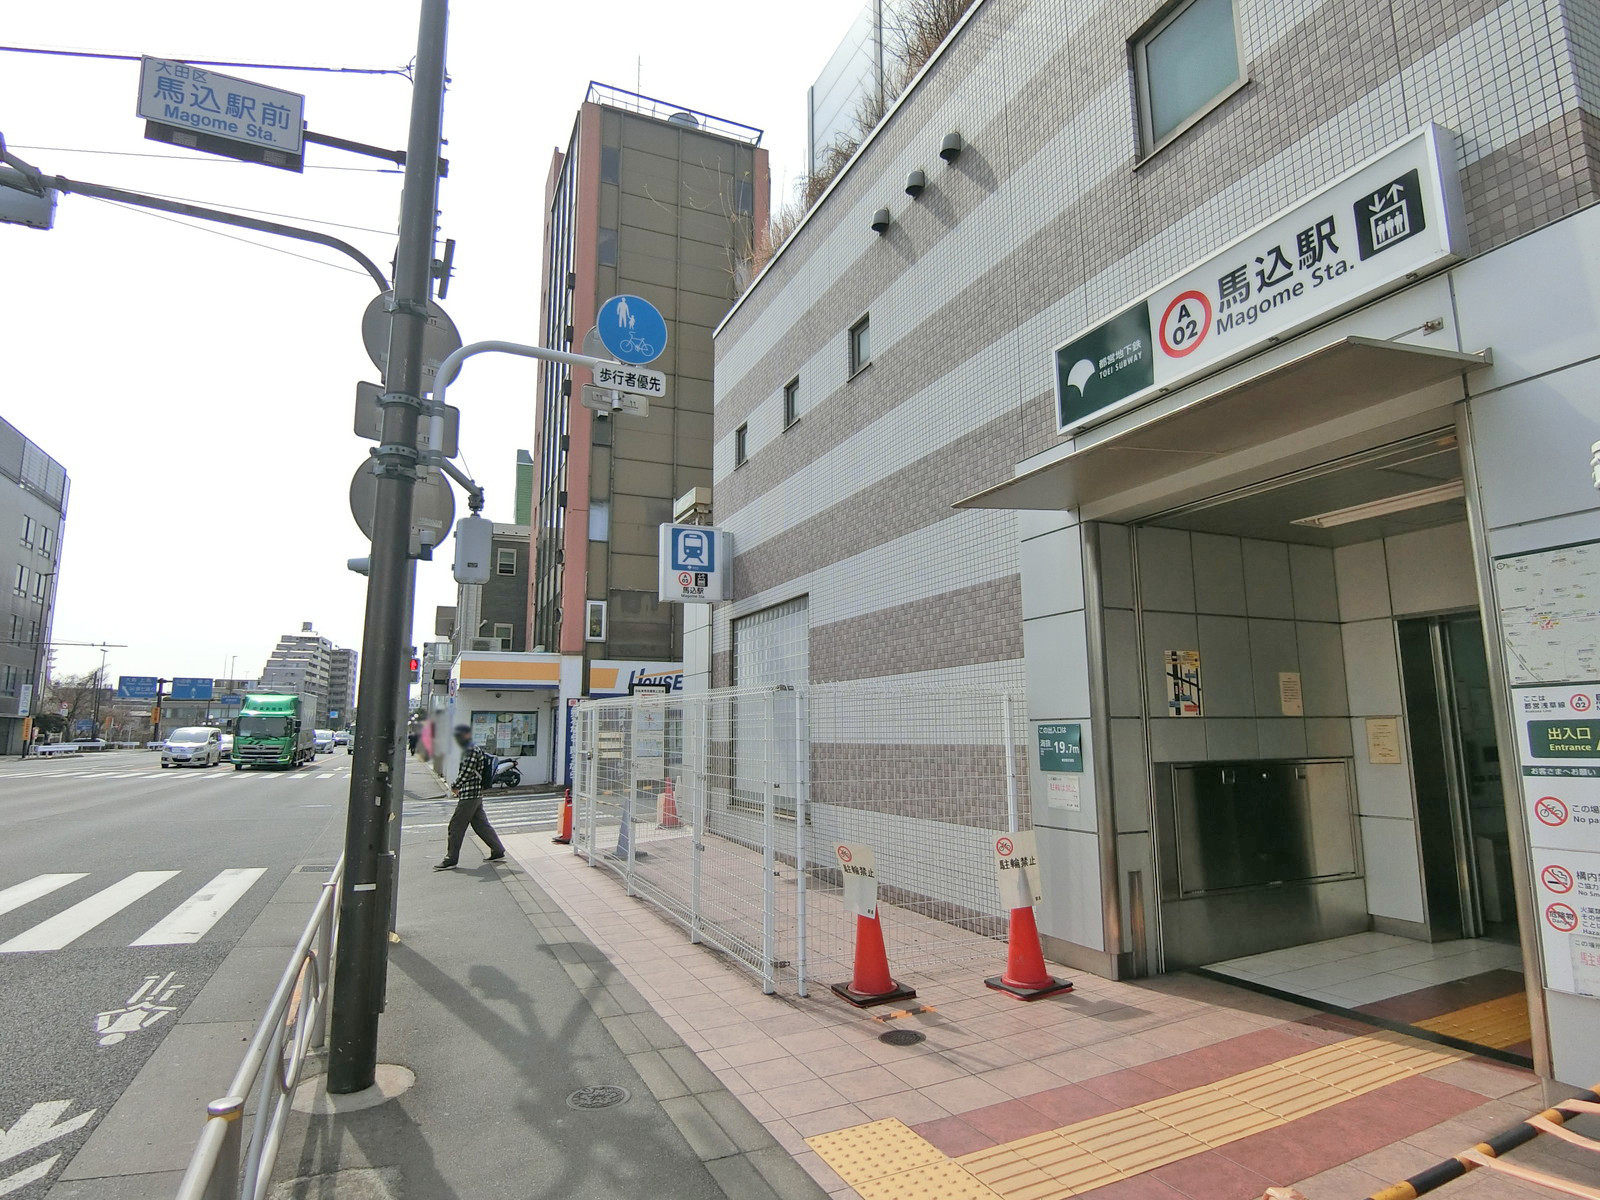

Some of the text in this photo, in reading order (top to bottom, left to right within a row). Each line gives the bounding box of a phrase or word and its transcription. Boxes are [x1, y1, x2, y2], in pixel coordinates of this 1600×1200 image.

[155, 61, 208, 84] 大田区
[153, 76, 291, 130] 馬込駅前
[164, 104, 277, 143] Magome Sta.
[1218, 215, 1340, 314] 馬込駅
[1216, 259, 1354, 335] Magome Sta.
[1177, 304, 1191, 323] A
[1173, 320, 1198, 345] 02
[1098, 339, 1142, 369] 都営地下鉄
[1099, 352, 1143, 380] TOEI SUBWAY
[600, 367, 661, 392] 歩行者優先
[682, 587, 704, 595] 馬込駅
[1524, 702, 1566, 710] 都営浅草線
[1548, 727, 1591, 740] 出入口
[1053, 741, 1080, 754] 19.7m
[1549, 743, 1592, 751] Entrance
[1530, 768, 1596, 776] お客さまへお願い
[843, 864, 875, 879] 駐輪禁止
[1000, 856, 1036, 870] 駐輪禁止
[1576, 870, 1600, 882] 構内
[1580, 952, 1600, 967] 駐
